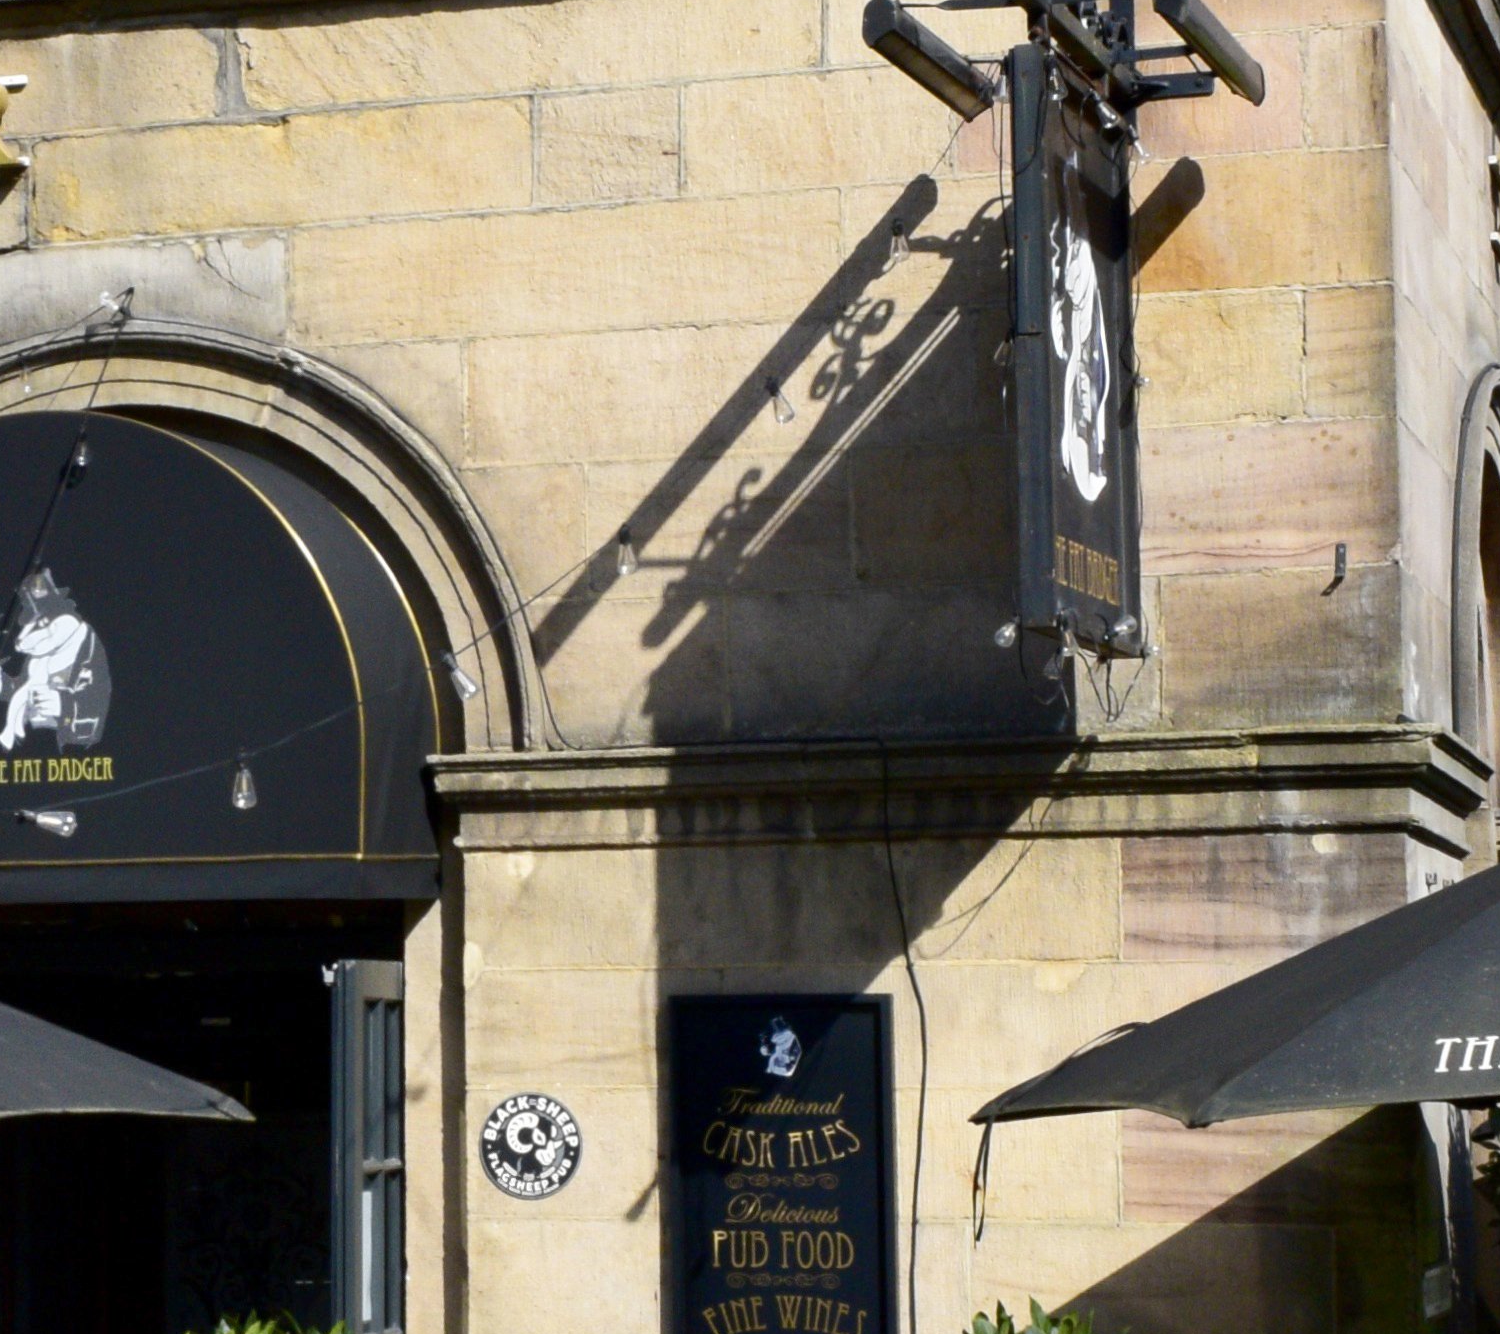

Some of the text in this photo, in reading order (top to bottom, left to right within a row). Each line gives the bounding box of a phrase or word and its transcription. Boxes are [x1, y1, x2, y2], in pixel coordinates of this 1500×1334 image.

[13, 758, 42, 783] FAT
[47, 756, 114, 782] BADGER
[717, 1087, 845, 1116] Traditional
[483, 1096, 580, 1148] BLACK SHEEP
[703, 1119, 861, 1168] CASK ALES
[551, 1158, 573, 1183] PUB
[725, 1192, 840, 1224] Delicious
[712, 1229, 855, 1269] PUB FOOD
